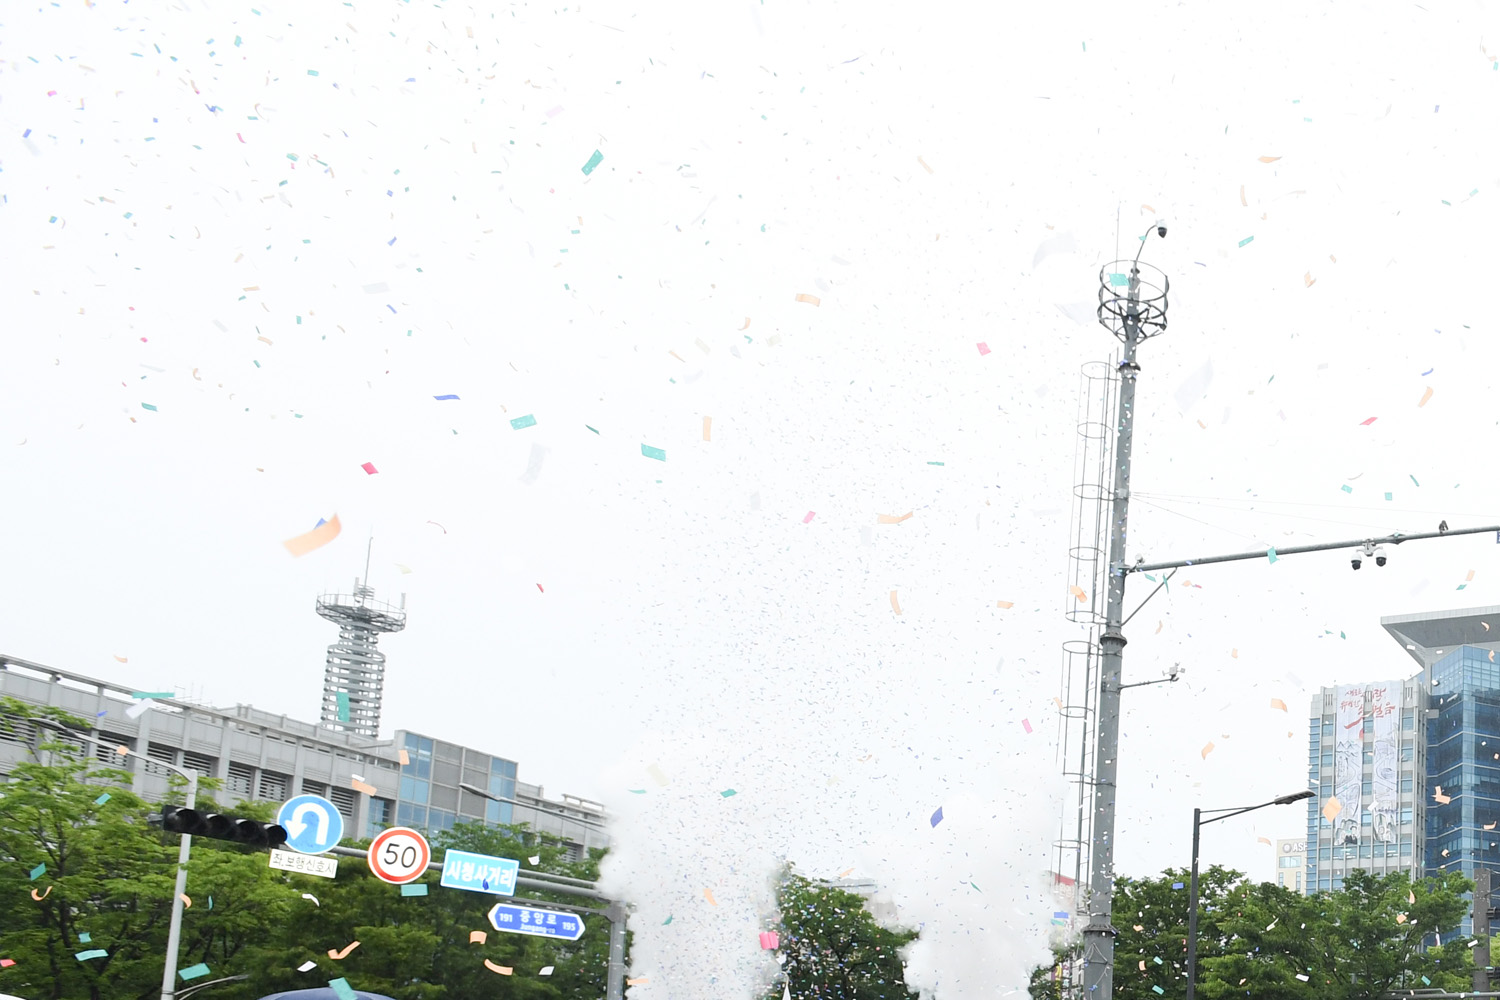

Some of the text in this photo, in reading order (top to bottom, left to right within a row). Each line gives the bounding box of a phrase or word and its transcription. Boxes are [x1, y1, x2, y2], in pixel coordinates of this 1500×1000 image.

[384, 842, 417, 869] 50
[446, 860, 514, 888] 시청사거리
[499, 909, 576, 932] 191 중앙로 195
[519, 922, 556, 936] Jungang-ro
